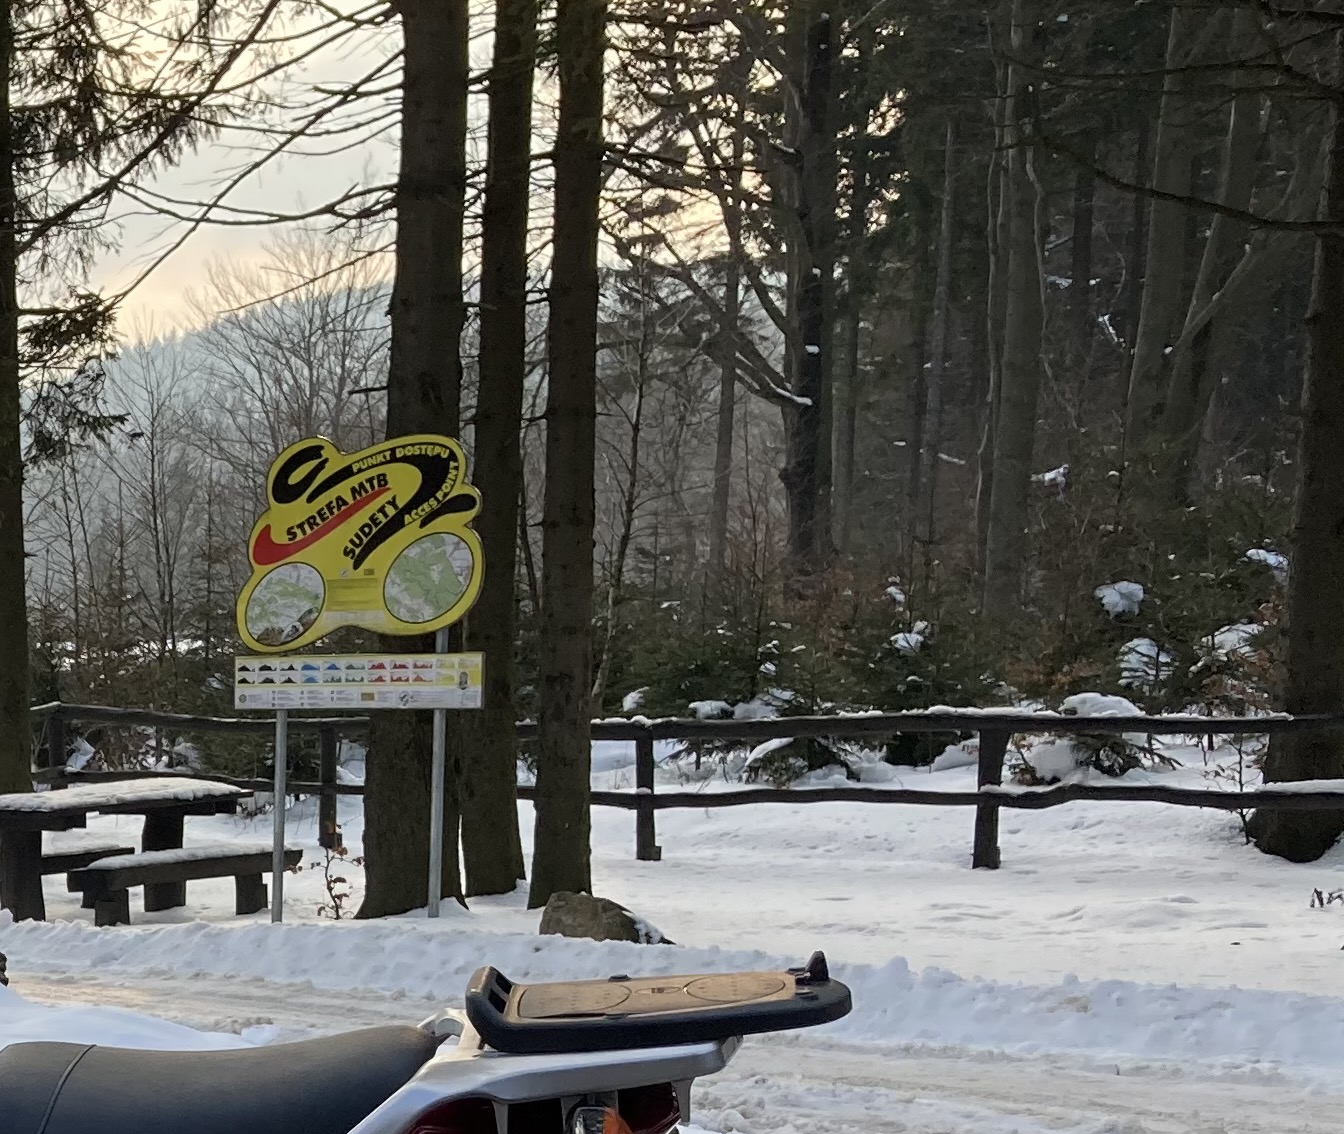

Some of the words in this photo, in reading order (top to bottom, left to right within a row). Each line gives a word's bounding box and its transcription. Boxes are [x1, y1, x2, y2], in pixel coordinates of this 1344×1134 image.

[352, 451, 391, 473] PUNKT
[435, 461, 459, 501] POINT
[286, 493, 351, 542] STREFA
[348, 473, 389, 503] MTB
[342, 494, 401, 561] SUDETY
